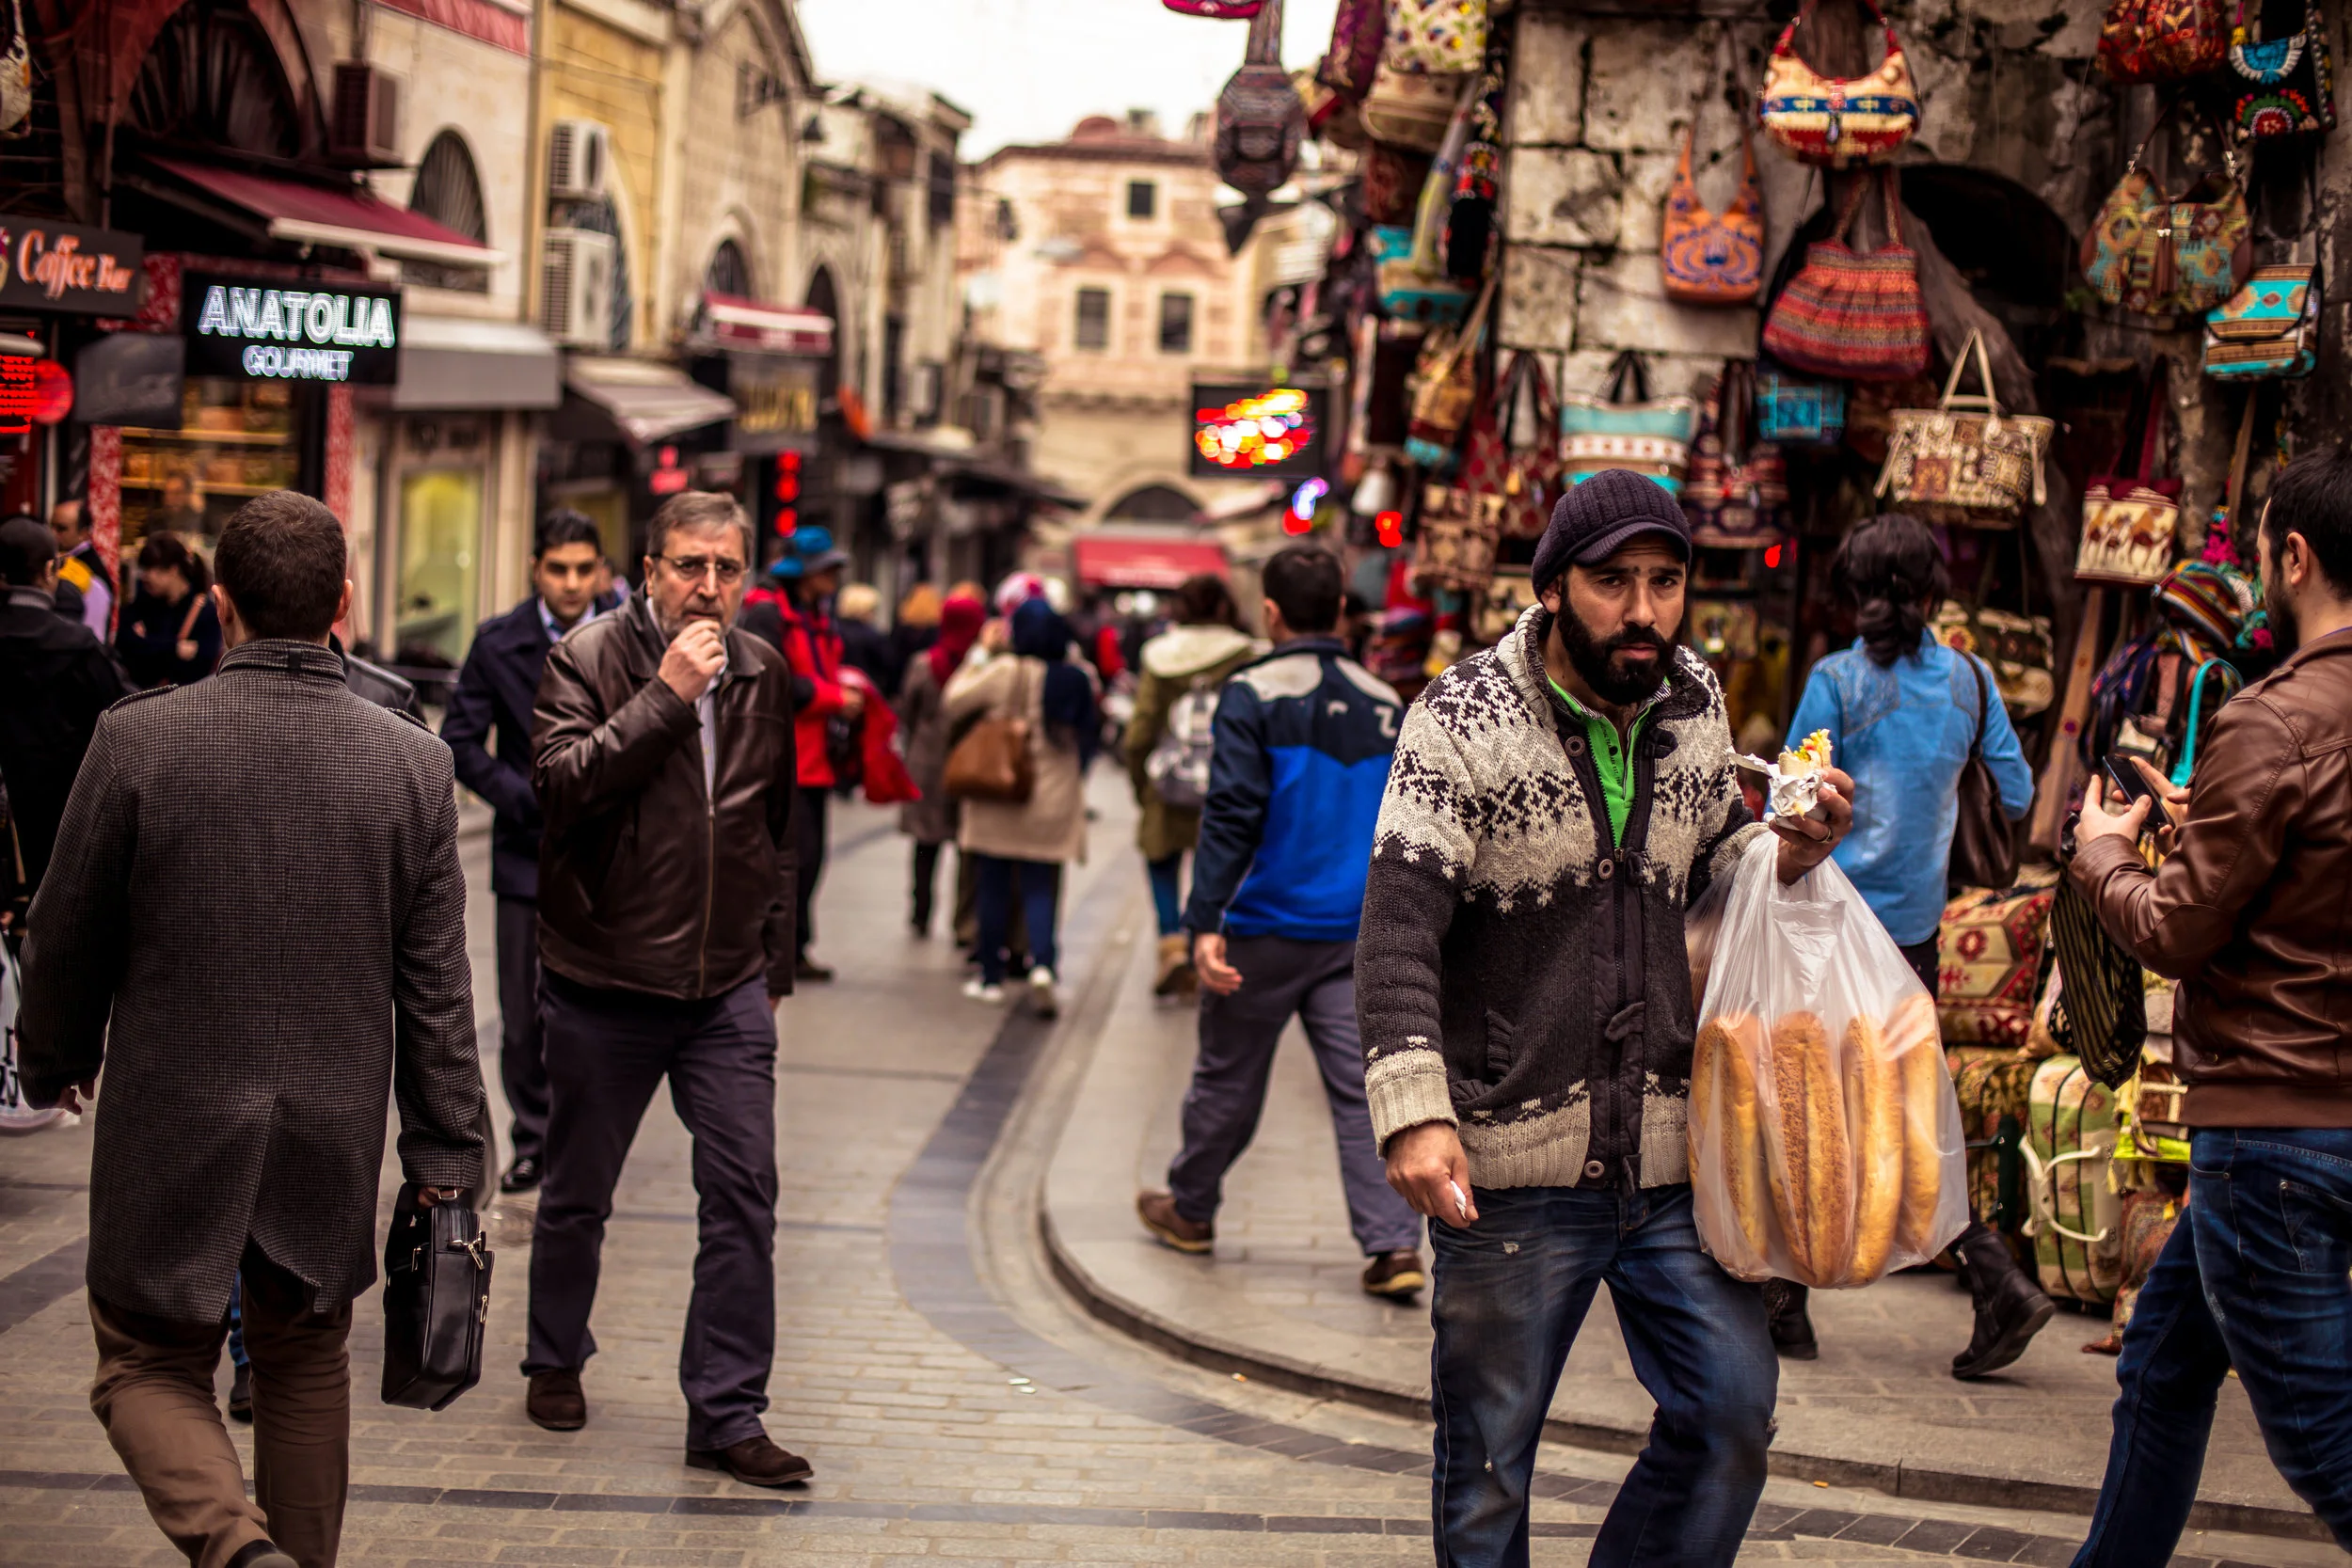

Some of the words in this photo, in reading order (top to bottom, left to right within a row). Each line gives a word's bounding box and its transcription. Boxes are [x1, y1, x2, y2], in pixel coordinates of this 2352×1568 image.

[18, 230, 96, 300] Coffee
[95, 254, 135, 293] Bar
[197, 285, 396, 349] ANATOLIA
[242, 344, 355, 382] GOURMET
